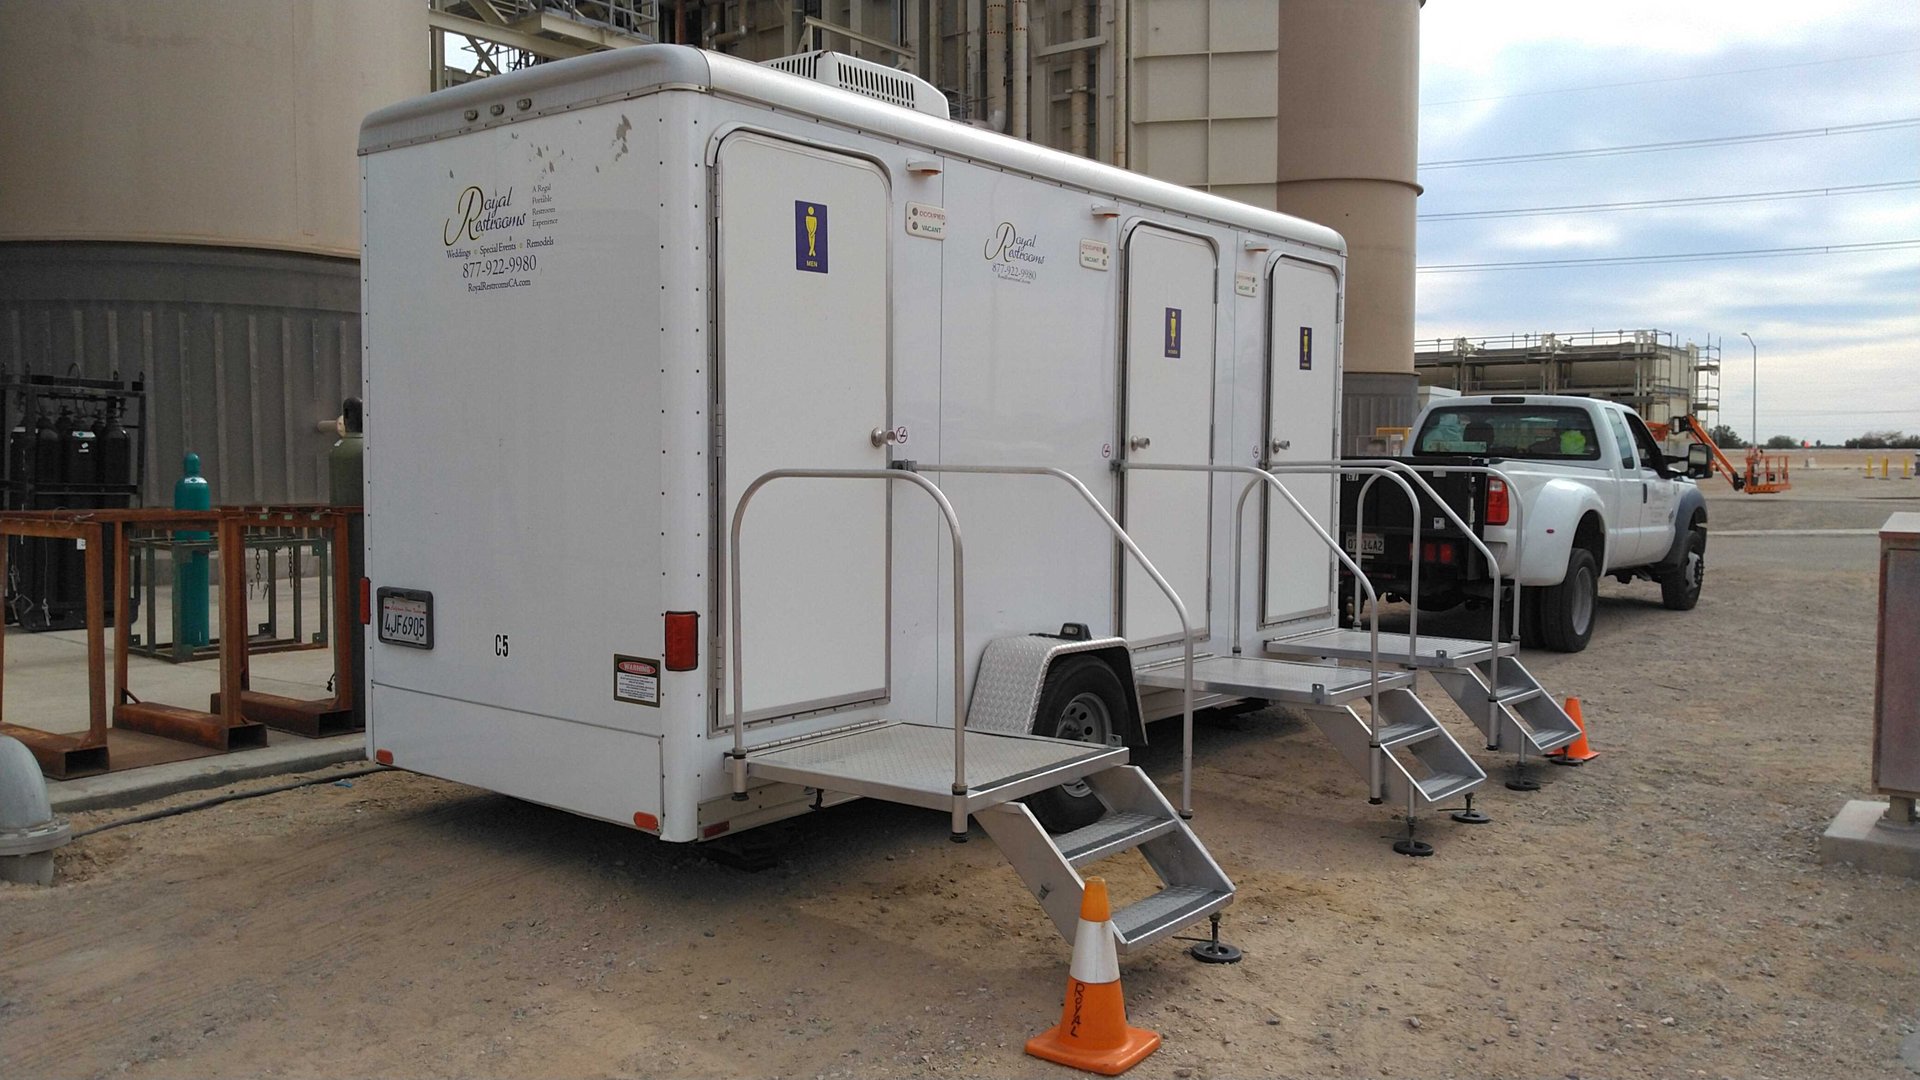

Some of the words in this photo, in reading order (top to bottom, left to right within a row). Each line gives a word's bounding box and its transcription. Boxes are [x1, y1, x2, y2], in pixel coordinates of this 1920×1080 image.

[919, 210, 945, 221] OCCUPIED
[921, 224, 942, 234] VACANT
[446, 248, 472, 260] Weddings
[480, 244, 498, 257] Special
[499, 242, 517, 252] Events
[527, 236, 554, 249] Remodels
[463, 254, 537, 279] 877-922-9980
[806, 260, 818, 268] MEN
[385, 613, 425, 637] 4JF6905
[495, 634, 509, 657] C5
[623, 662, 652, 673] WARNING
